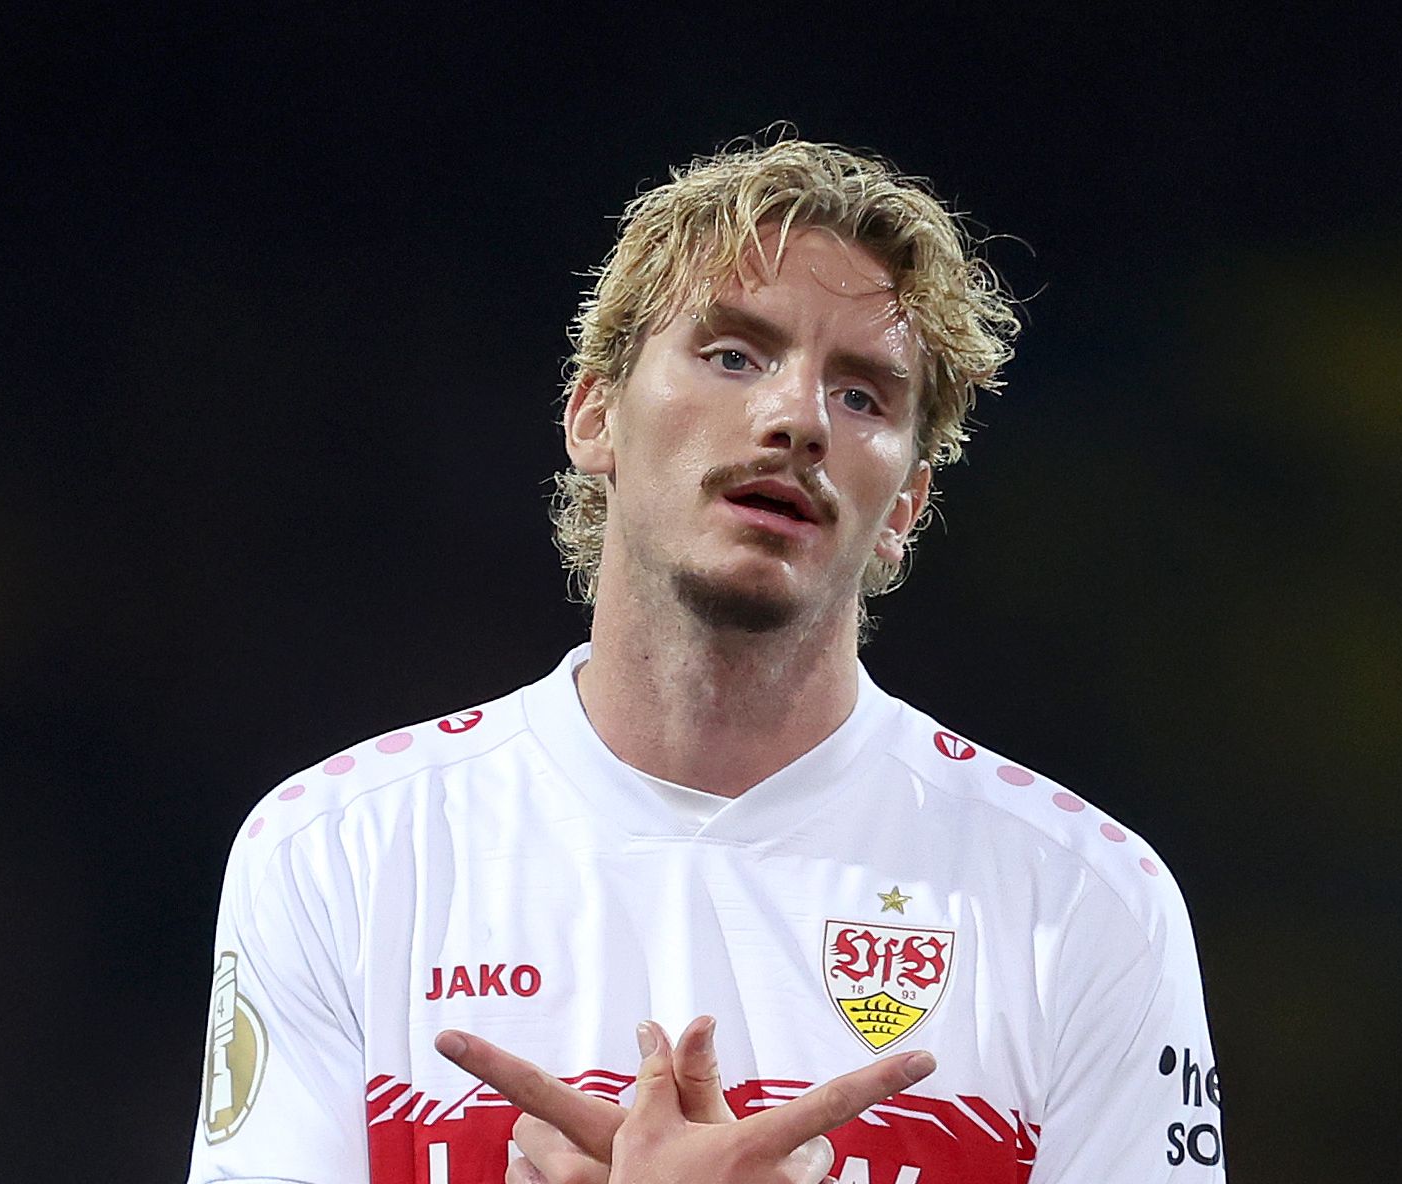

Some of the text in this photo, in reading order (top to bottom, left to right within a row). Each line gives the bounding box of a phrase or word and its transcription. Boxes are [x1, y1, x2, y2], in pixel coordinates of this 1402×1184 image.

[830, 929, 948, 989] VfB
[425, 963, 542, 1001] JAKO
[850, 984, 865, 995] 18
[901, 990, 917, 1001] 93
